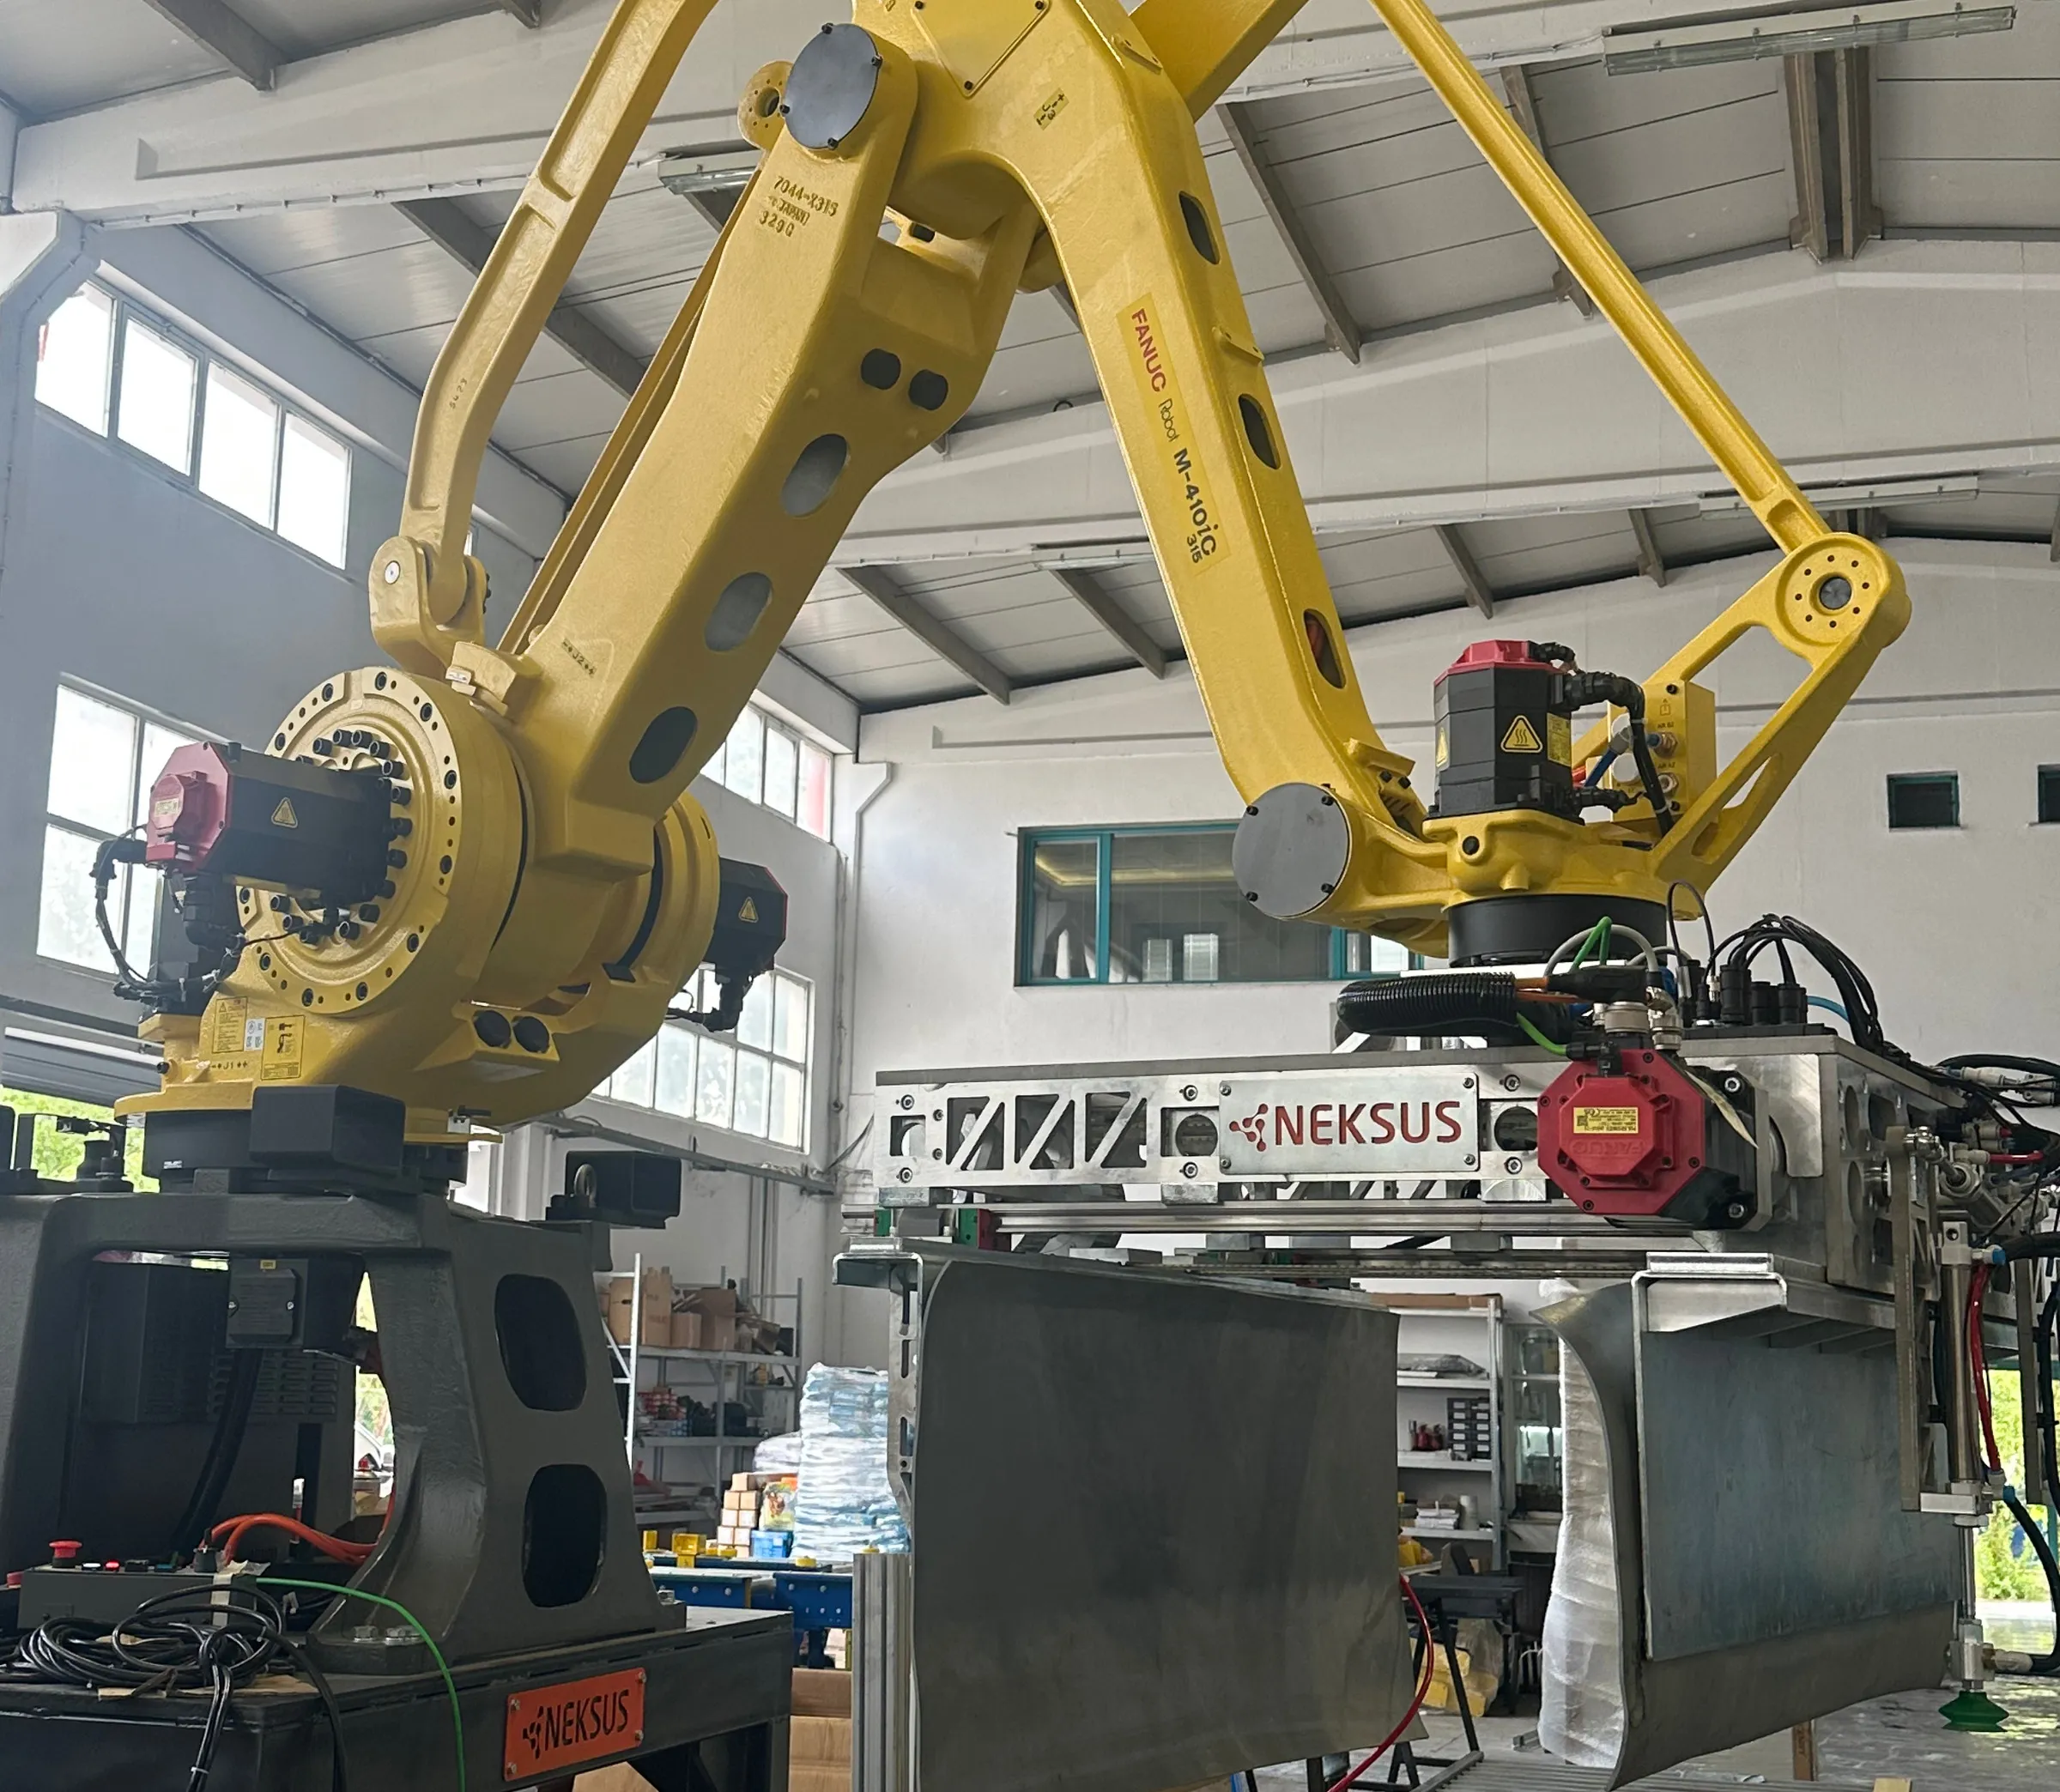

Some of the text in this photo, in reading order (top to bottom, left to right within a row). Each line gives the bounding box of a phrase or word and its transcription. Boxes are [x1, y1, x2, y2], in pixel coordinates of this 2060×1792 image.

[1131, 307, 1166, 392] FANUC
[1158, 397, 1180, 442] Robot
[1275, 1100, 1462, 1146] NEKSUS
[544, 1688, 629, 1751] NEKSUS
